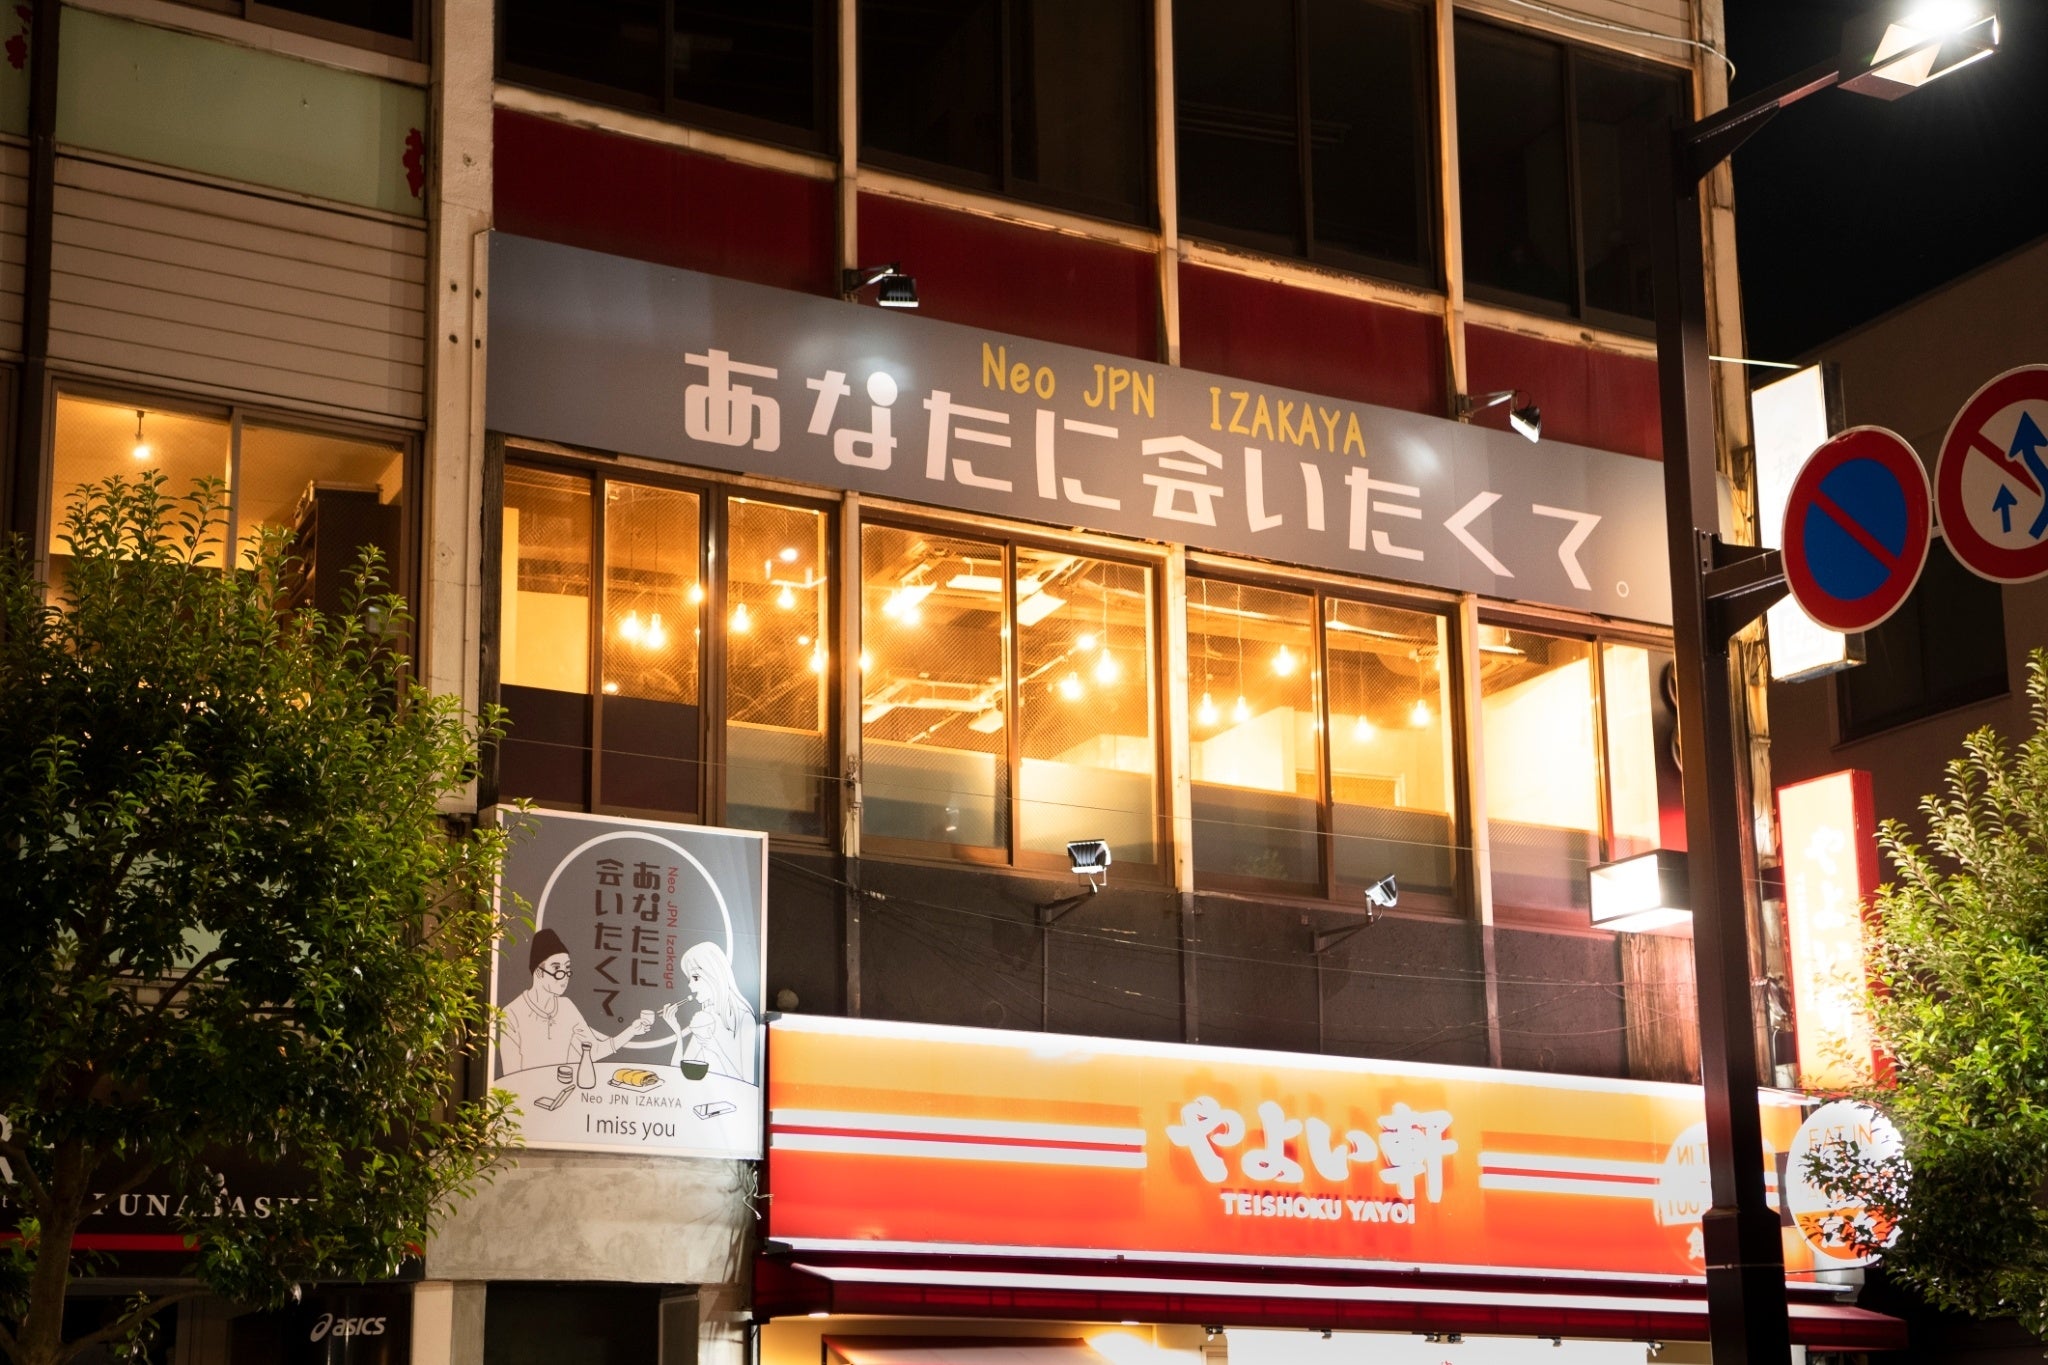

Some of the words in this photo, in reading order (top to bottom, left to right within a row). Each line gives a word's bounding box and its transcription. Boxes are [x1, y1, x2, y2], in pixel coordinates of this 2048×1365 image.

[981, 341, 1056, 400] Neo
[1083, 364, 1155, 418] JPN
[1209, 386, 1367, 458] IZAKAYA
[684, 348, 1630, 598] あなたに会いたくて。
[666, 866, 678, 894] Neo
[631, 861, 661, 987] あなたに
[666, 901, 678, 928] JPN
[593, 858, 624, 1023] 会いたくて。
[663, 935, 678, 990] Izakaya
[581, 1092, 603, 1104] Neo
[609, 1094, 629, 1105] JPN
[635, 1096, 682, 1108] IZAKAYA
[586, 1114, 590, 1133] I
[596, 1116, 637, 1135] miss
[642, 1122, 675, 1141] you
[1165, 1095, 1459, 1203] やよい軒
[1853, 1123, 1874, 1146] IN
[1219, 1192, 1342, 1221] TEISHOKU
[1347, 1199, 1416, 1224] YAYOI
